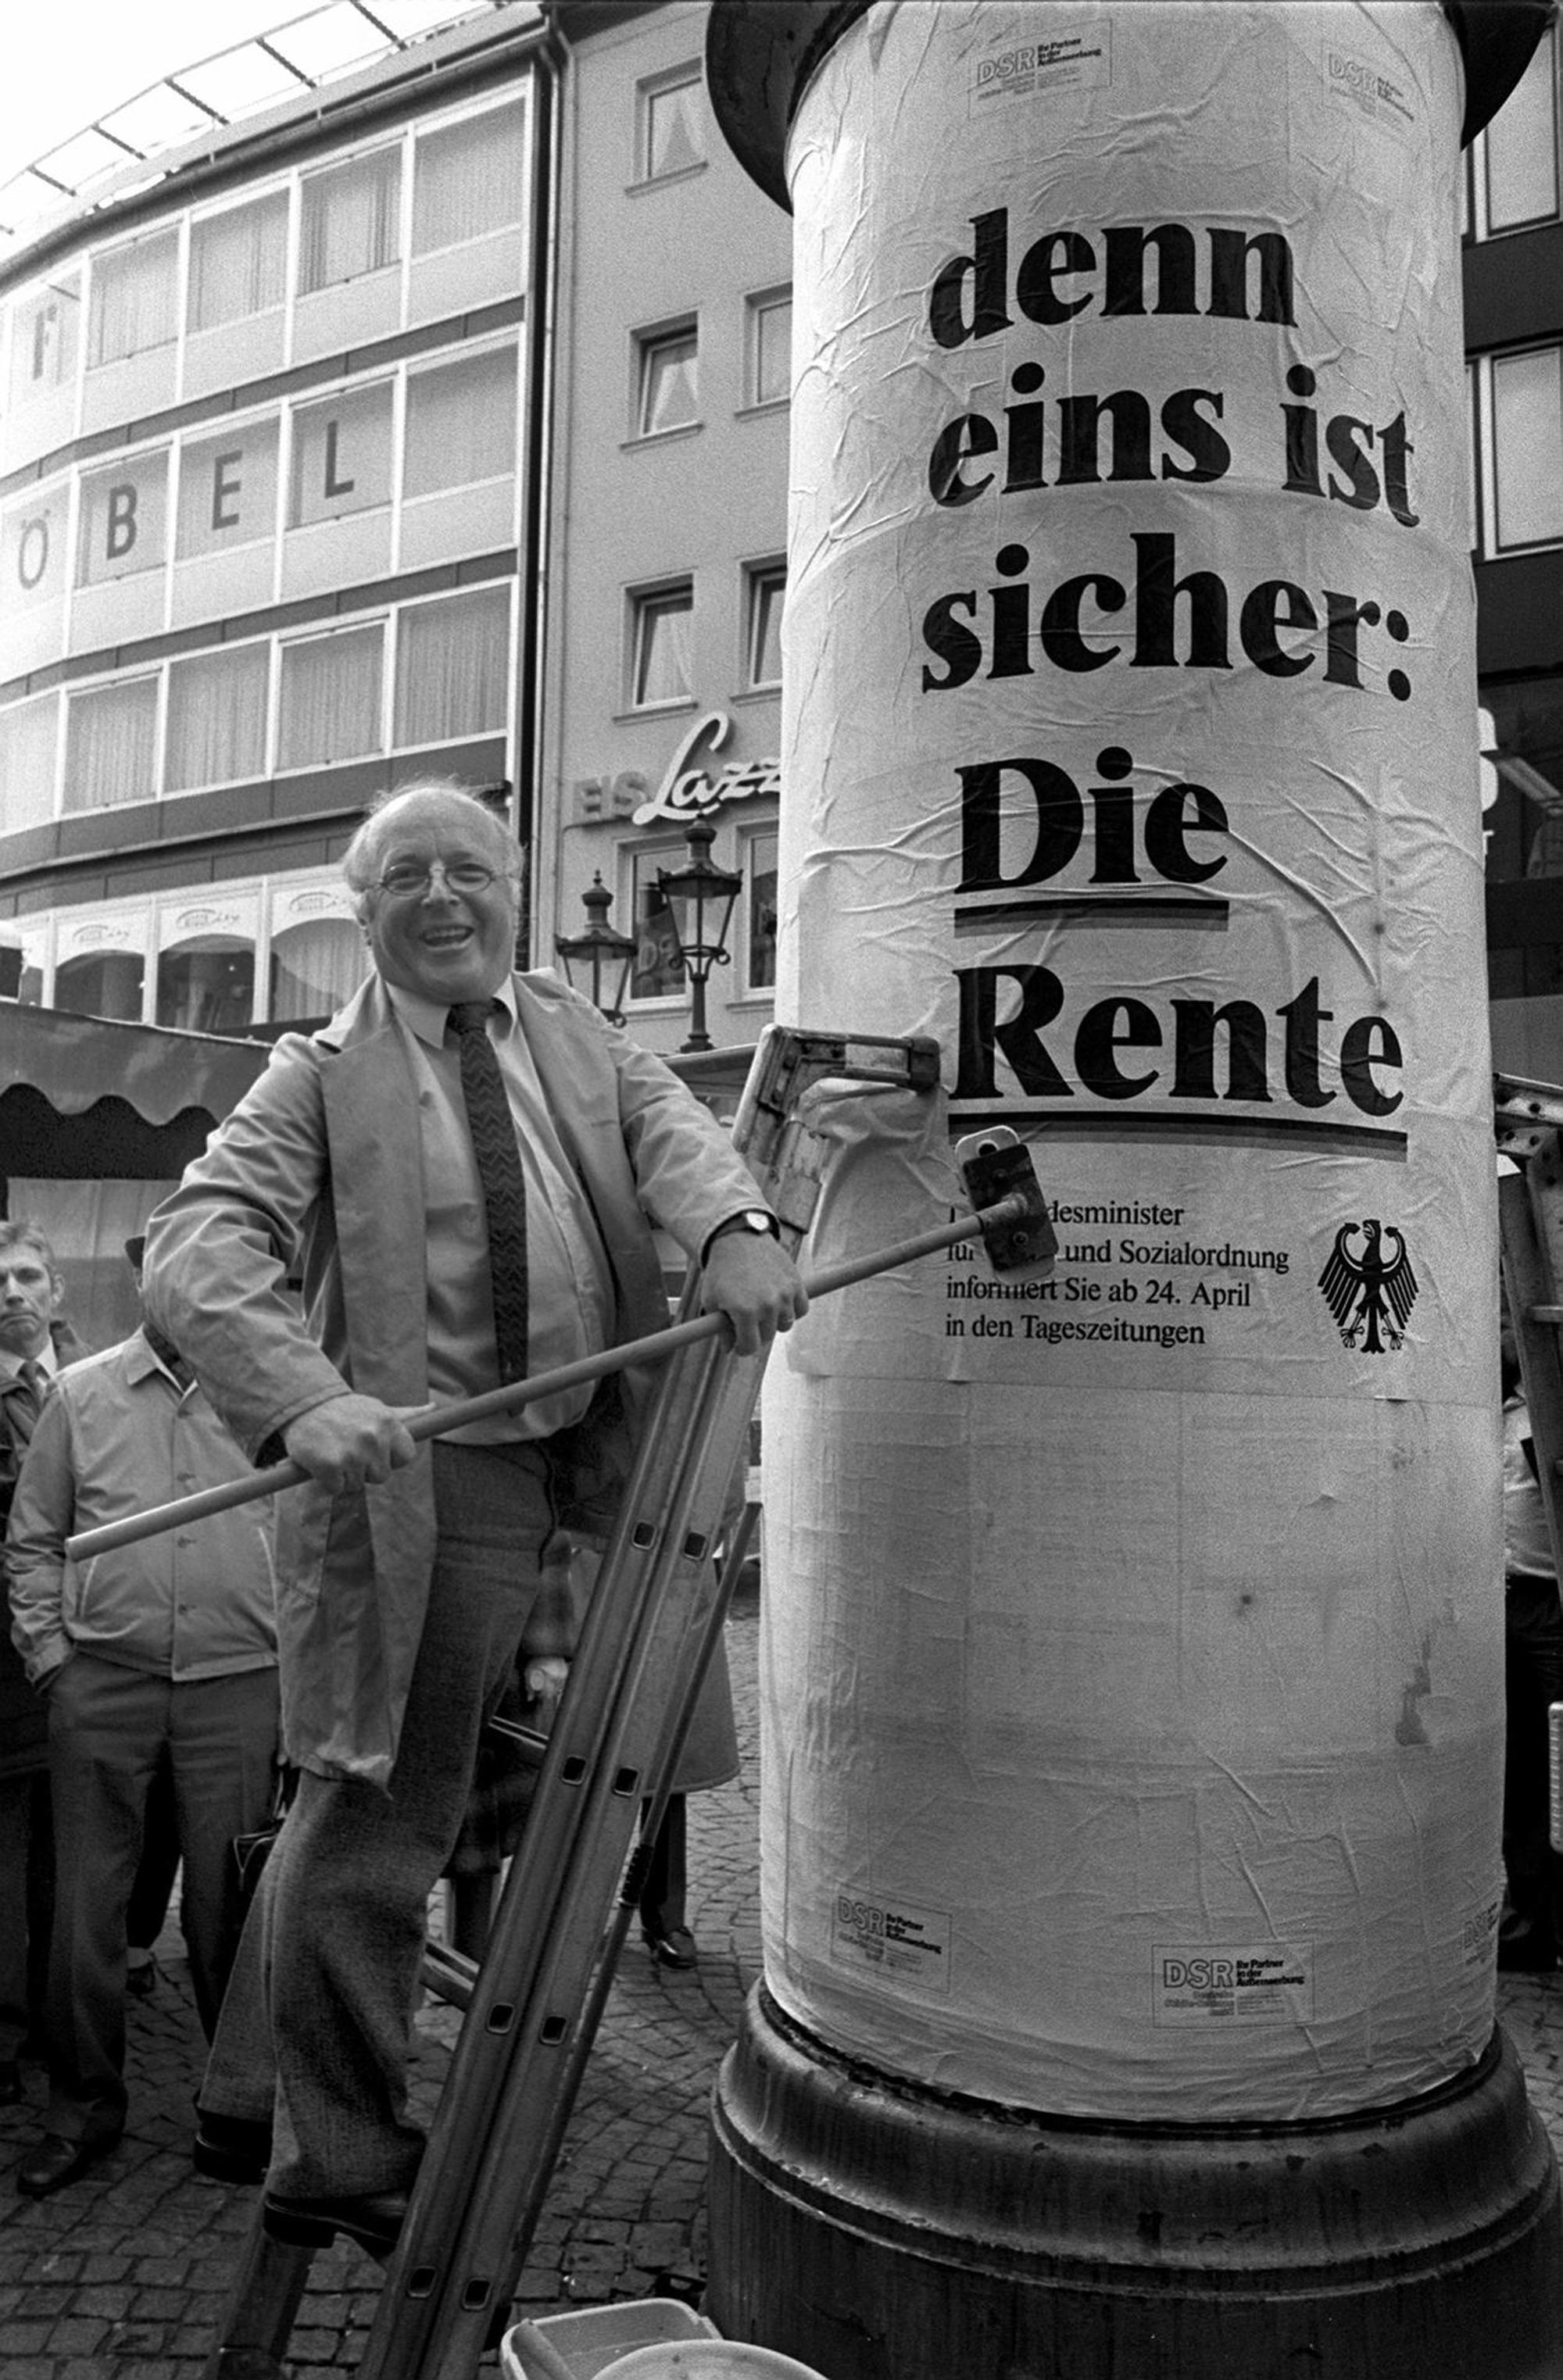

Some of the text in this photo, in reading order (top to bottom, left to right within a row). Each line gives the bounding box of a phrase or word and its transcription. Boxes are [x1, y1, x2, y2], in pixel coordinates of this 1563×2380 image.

[978, 47, 1035, 88] DSR
[929, 207, 1299, 349] denn
[928, 363, 1420, 528] eins ist
[922, 533, 1411, 702] sicher:
[953, 747, 1229, 894] Die
[948, 964, 1404, 1117] Rente
[1047, 1199, 1186, 1227] desminister
[1064, 1238, 1112, 1263] und
[1119, 1238, 1290, 1275] Sozialordnung
[946, 1274, 1252, 1311] informiert Sie ab 24. April
[945, 1313, 1206, 1349] in den Tageszeitungen
[838, 1896, 885, 1936] DSR
[1164, 1958, 1234, 1989] DSR
